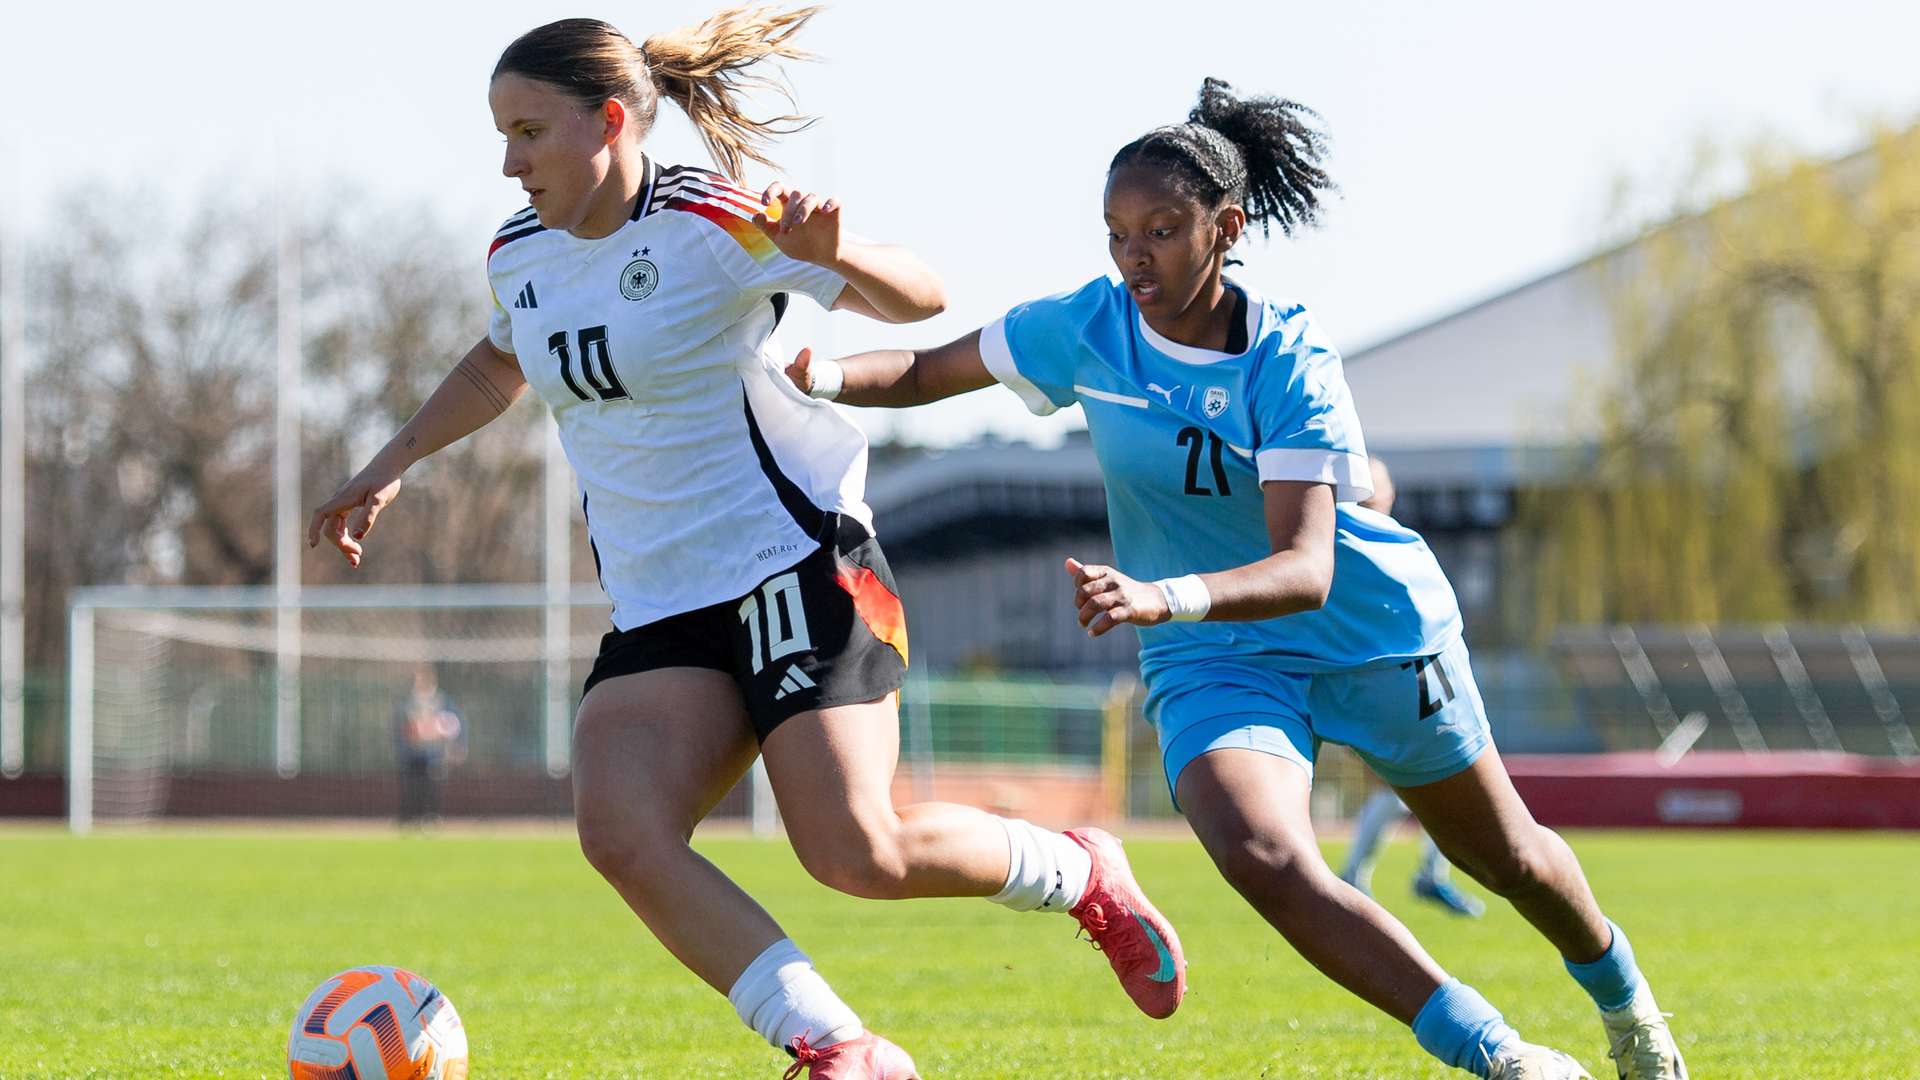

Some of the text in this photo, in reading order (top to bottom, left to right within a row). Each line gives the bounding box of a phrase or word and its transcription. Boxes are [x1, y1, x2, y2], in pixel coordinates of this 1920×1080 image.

[548, 325, 634, 402] 10
[1176, 426, 1232, 496] 21
[738, 572, 811, 676] 10
[1400, 655, 1455, 720] 21
